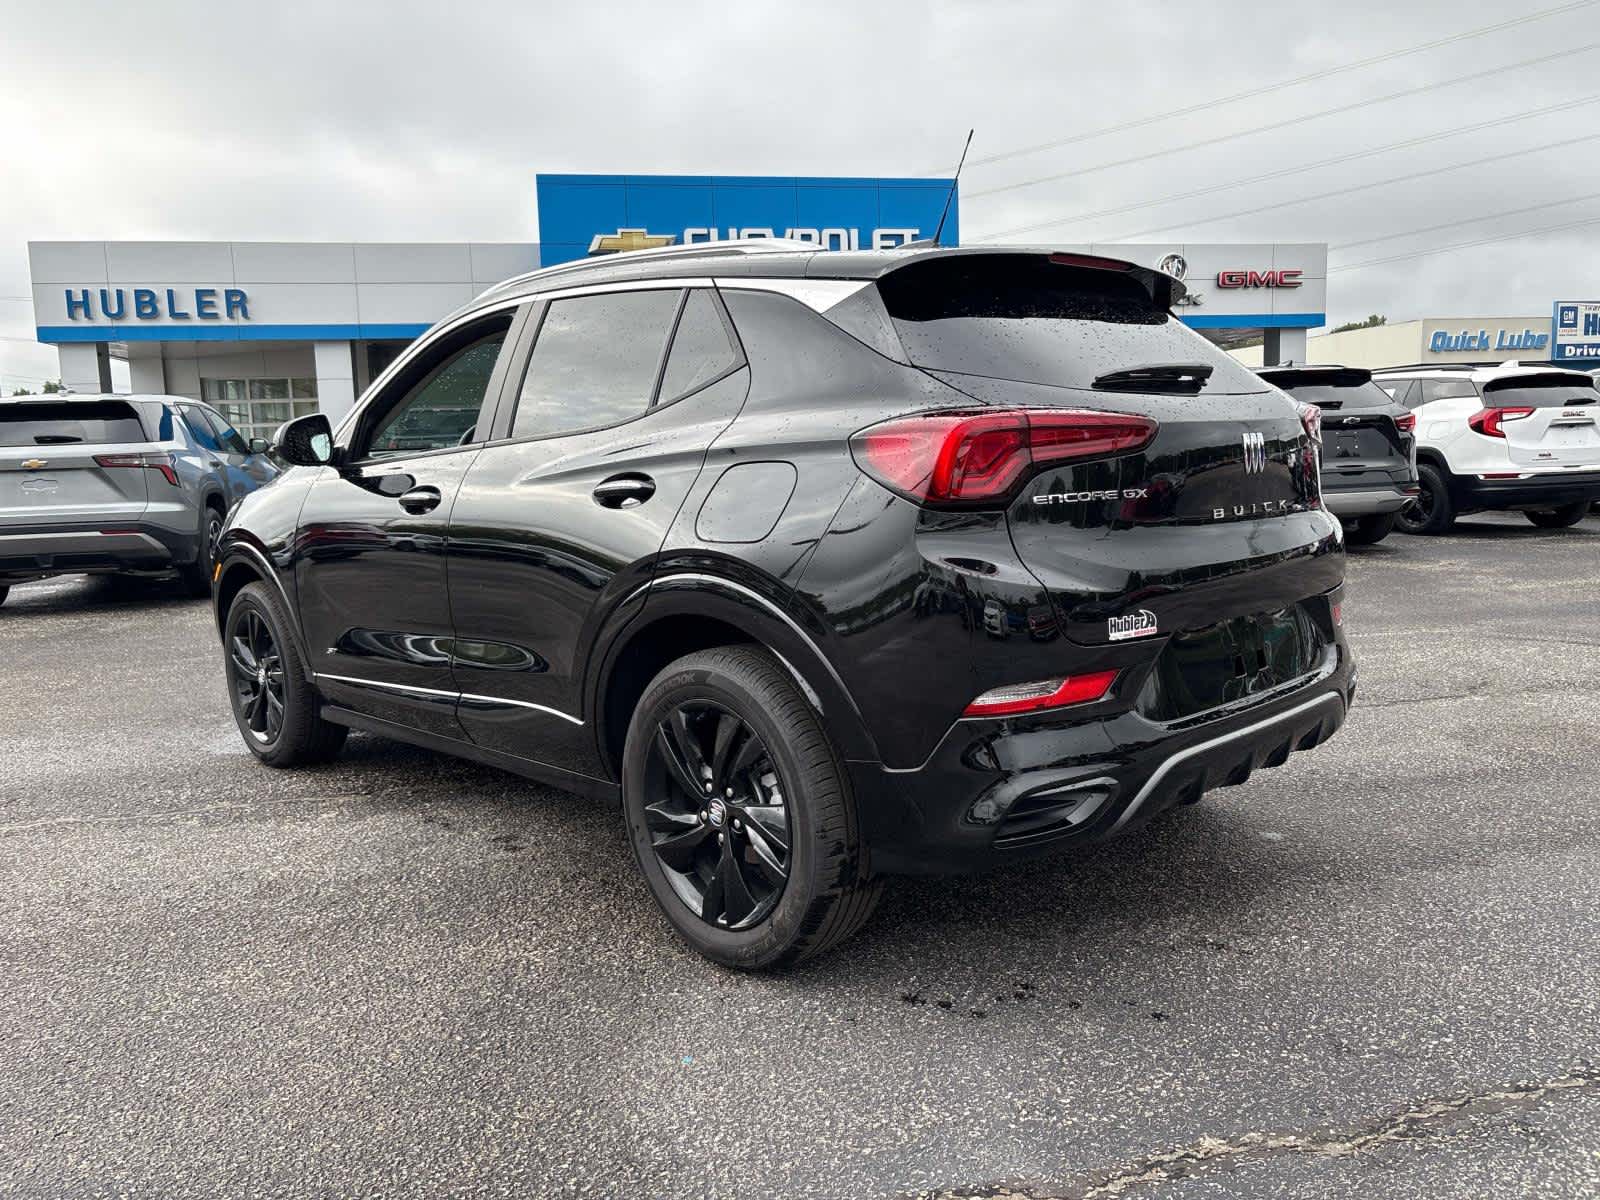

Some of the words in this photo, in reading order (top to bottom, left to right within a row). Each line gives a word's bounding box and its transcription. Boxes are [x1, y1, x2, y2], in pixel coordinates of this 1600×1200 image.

[1217, 270, 1304, 289] GMC
[65, 288, 250, 321] HUBLER
[1563, 311, 1575, 321] GM
[1583, 313, 1600, 336] H
[1430, 330, 1490, 352] Quick
[1494, 329, 1549, 351] Lube
[1562, 410, 1586, 418] GMC
[1032, 490, 1119, 505] ENCORE
[1122, 488, 1148, 499] GX
[1213, 499, 1288, 520] BUICK
[1109, 615, 1147, 634] Hubler
